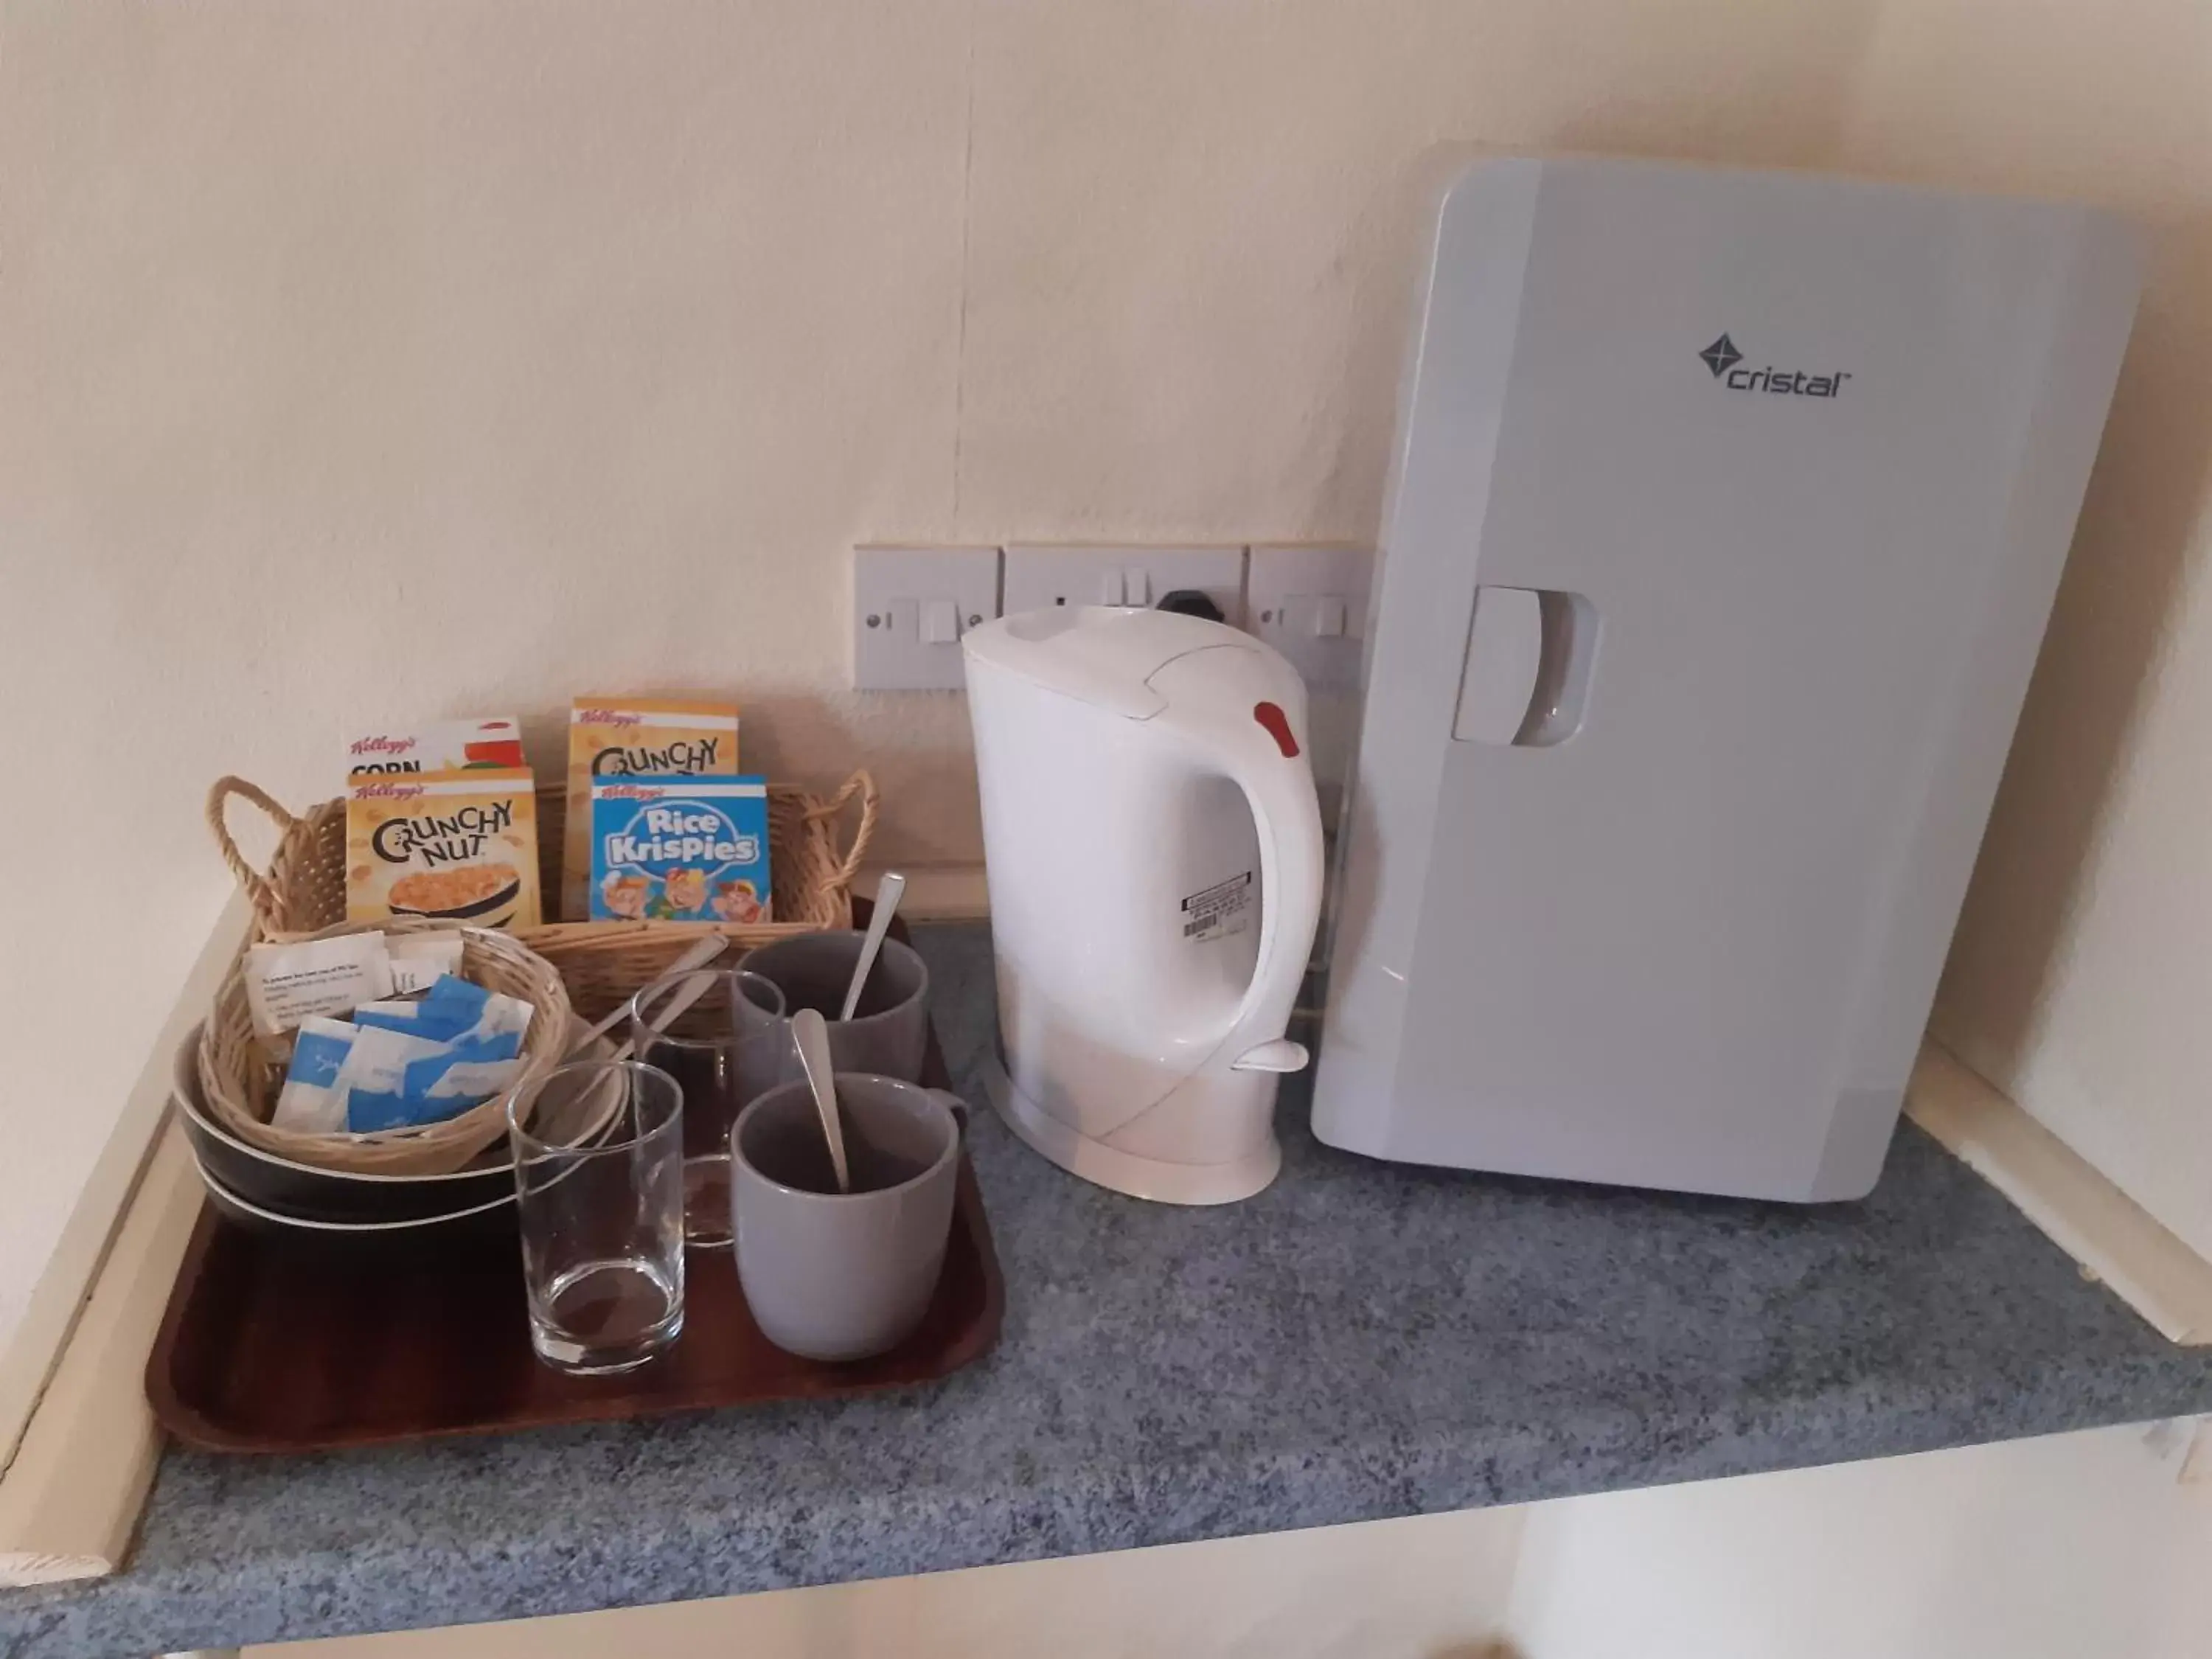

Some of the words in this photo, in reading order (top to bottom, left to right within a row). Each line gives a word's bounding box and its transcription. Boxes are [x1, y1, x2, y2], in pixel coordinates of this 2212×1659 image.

[1727, 366, 1840, 398] cristal
[350, 735, 417, 754] Kellogg's
[355, 783, 424, 801] Kellogg's
[372, 799, 512, 863] CRUNCHY
[646, 808, 721, 835] Rice
[421, 834, 488, 868] NUT
[611, 835, 758, 863] Krispies
